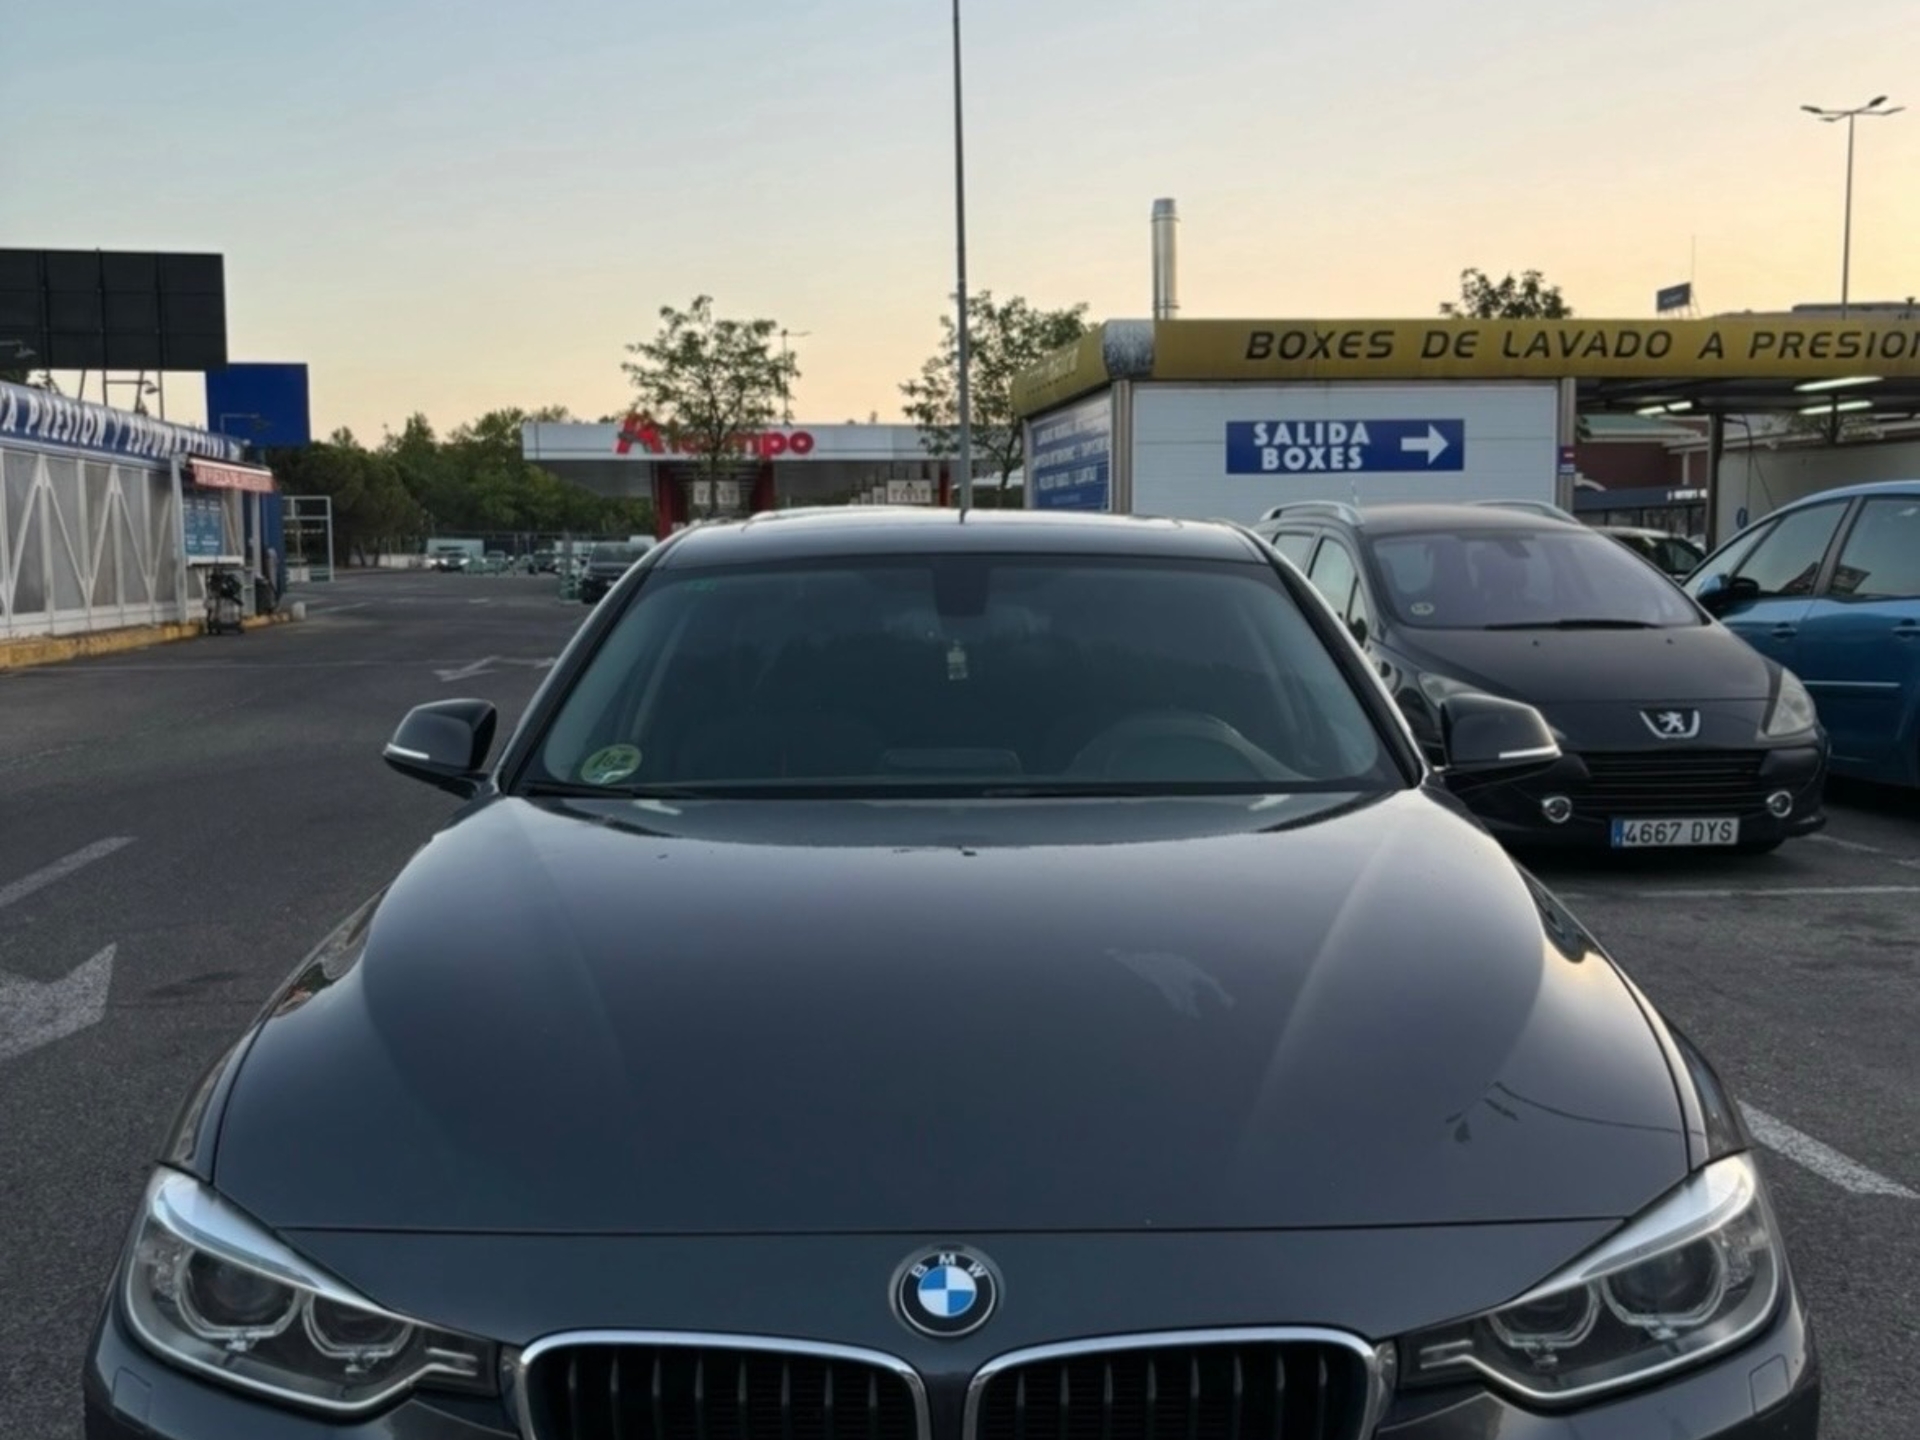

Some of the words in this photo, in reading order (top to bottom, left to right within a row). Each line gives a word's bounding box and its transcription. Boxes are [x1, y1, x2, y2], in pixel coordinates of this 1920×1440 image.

[1244, 329, 1395, 361] BOXES
[1420, 329, 1480, 360] DE
[1501, 329, 1673, 359] LAVADO
[1697, 330, 1725, 360] A
[1253, 421, 1371, 446] SALIDA
[1261, 446, 1363, 470] BOXES
[1624, 821, 1682, 844] 4667
[1690, 820, 1733, 843] DYS
[910, 1252, 988, 1279] BMW
